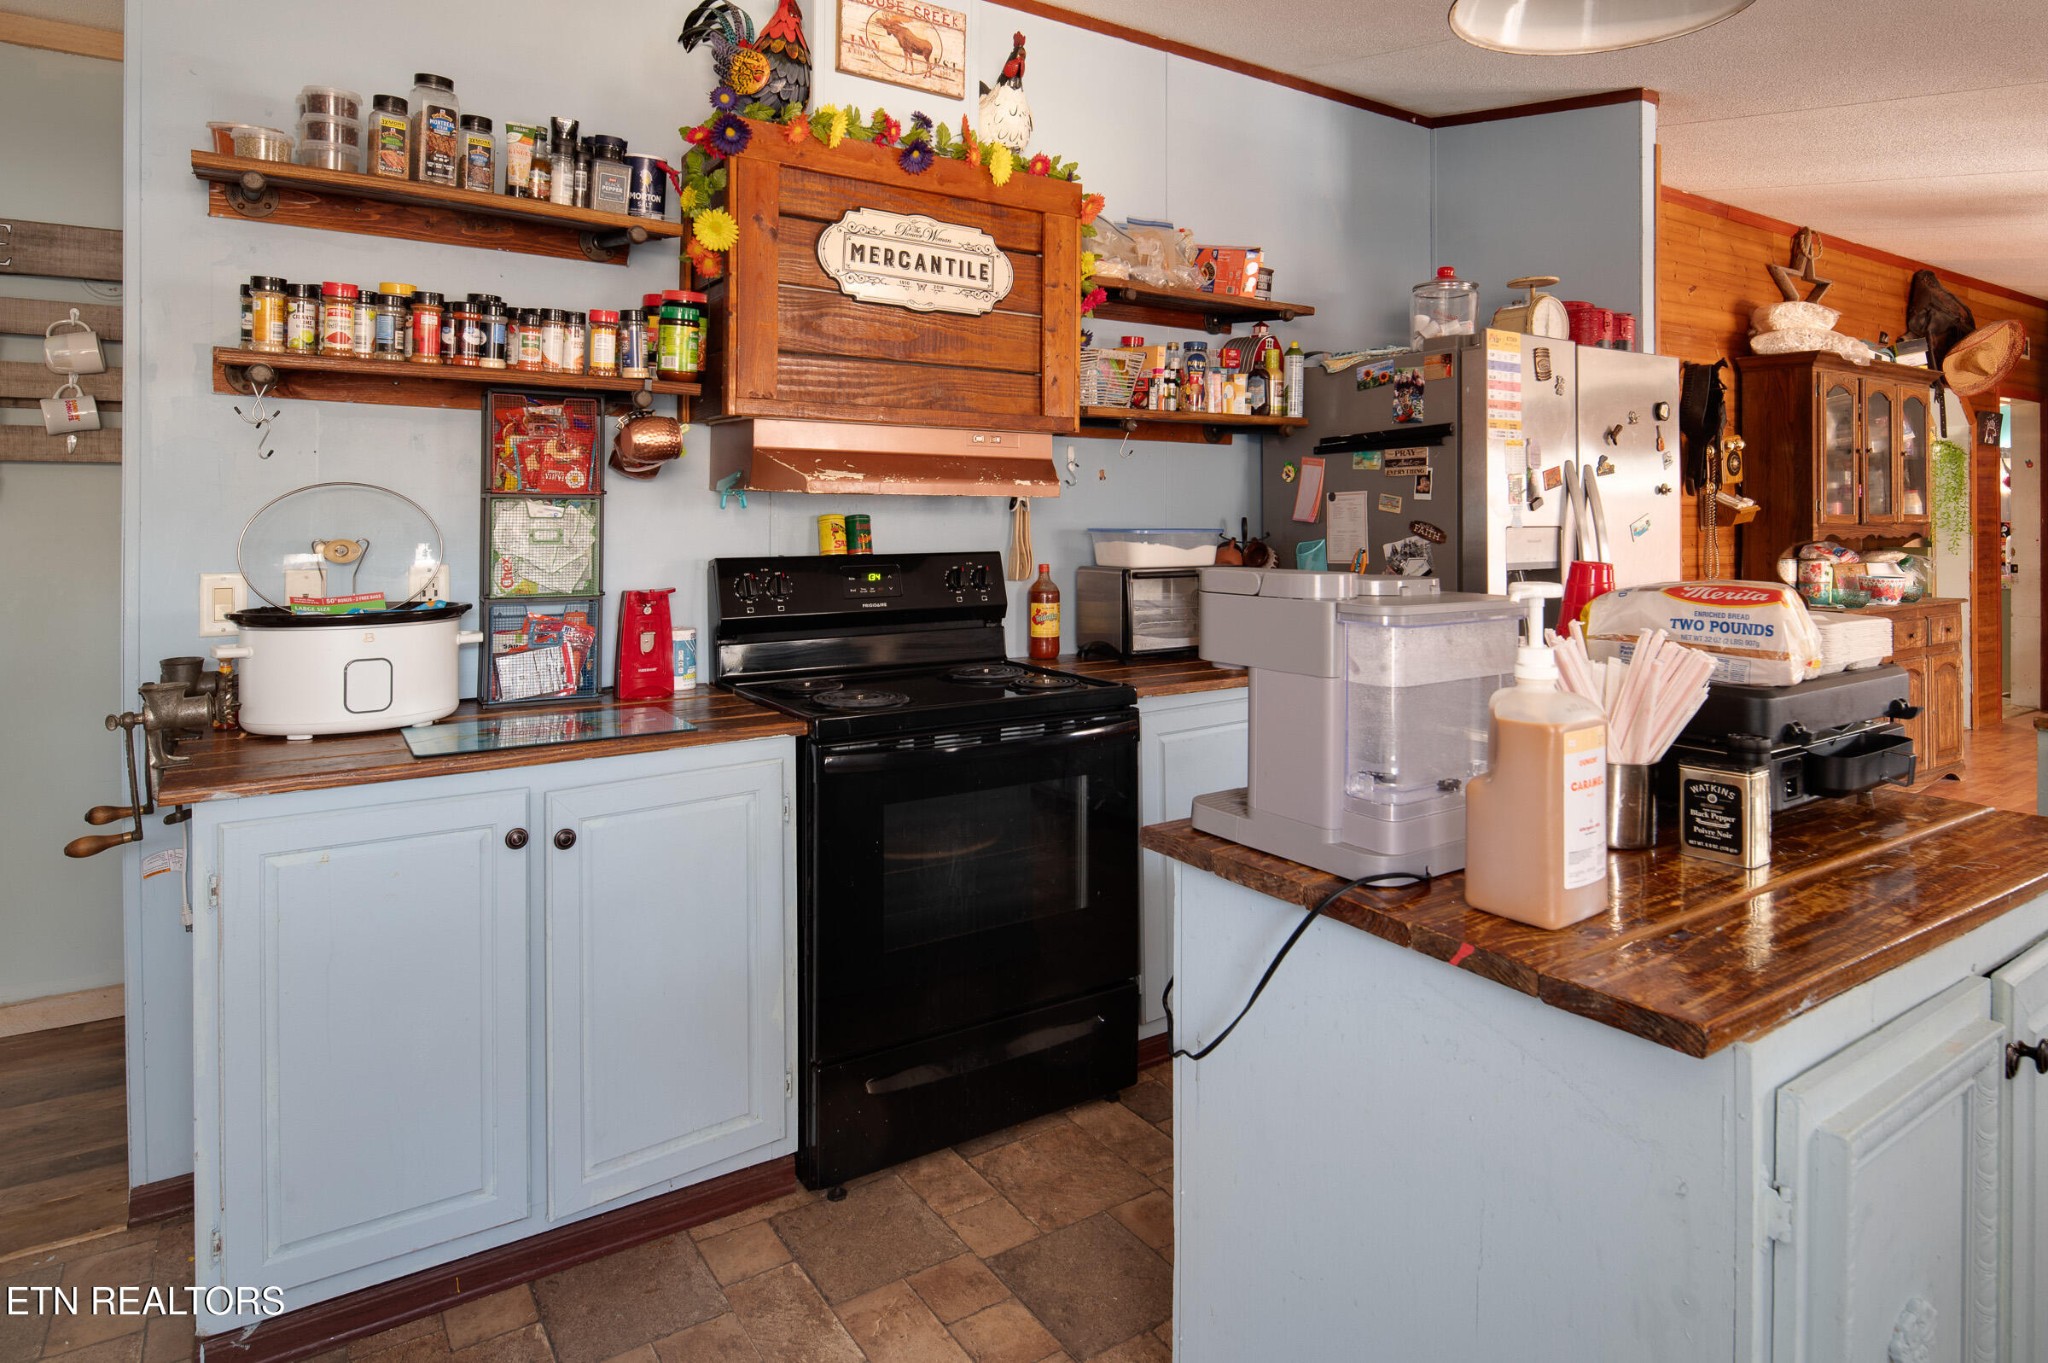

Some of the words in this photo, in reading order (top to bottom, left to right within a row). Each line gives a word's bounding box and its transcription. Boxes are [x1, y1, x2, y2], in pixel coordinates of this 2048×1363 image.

[913, 5, 958, 27] CREEK
[850, 34, 880, 53] INN
[602, 185, 622, 194] PEPPER
[629, 192, 661, 203] MORTON
[850, 242, 990, 283] MERCANTILE
[1394, 448, 1416, 457] PRAY
[1413, 523, 1441, 541] FAITH
[501, 556, 514, 589] Chex
[1681, 586, 1770, 601] Merita
[1694, 611, 1726, 619] ENRICHED
[1670, 618, 1705, 631] TWO
[1709, 620, 1774, 637] POUNDS
[1690, 784, 1735, 800] WATKINS
[1690, 809, 1709, 818] Black
[1711, 812, 1736, 823] Pepper
[1693, 826, 1716, 836] Poivre
[1717, 830, 1733, 839] Noir
